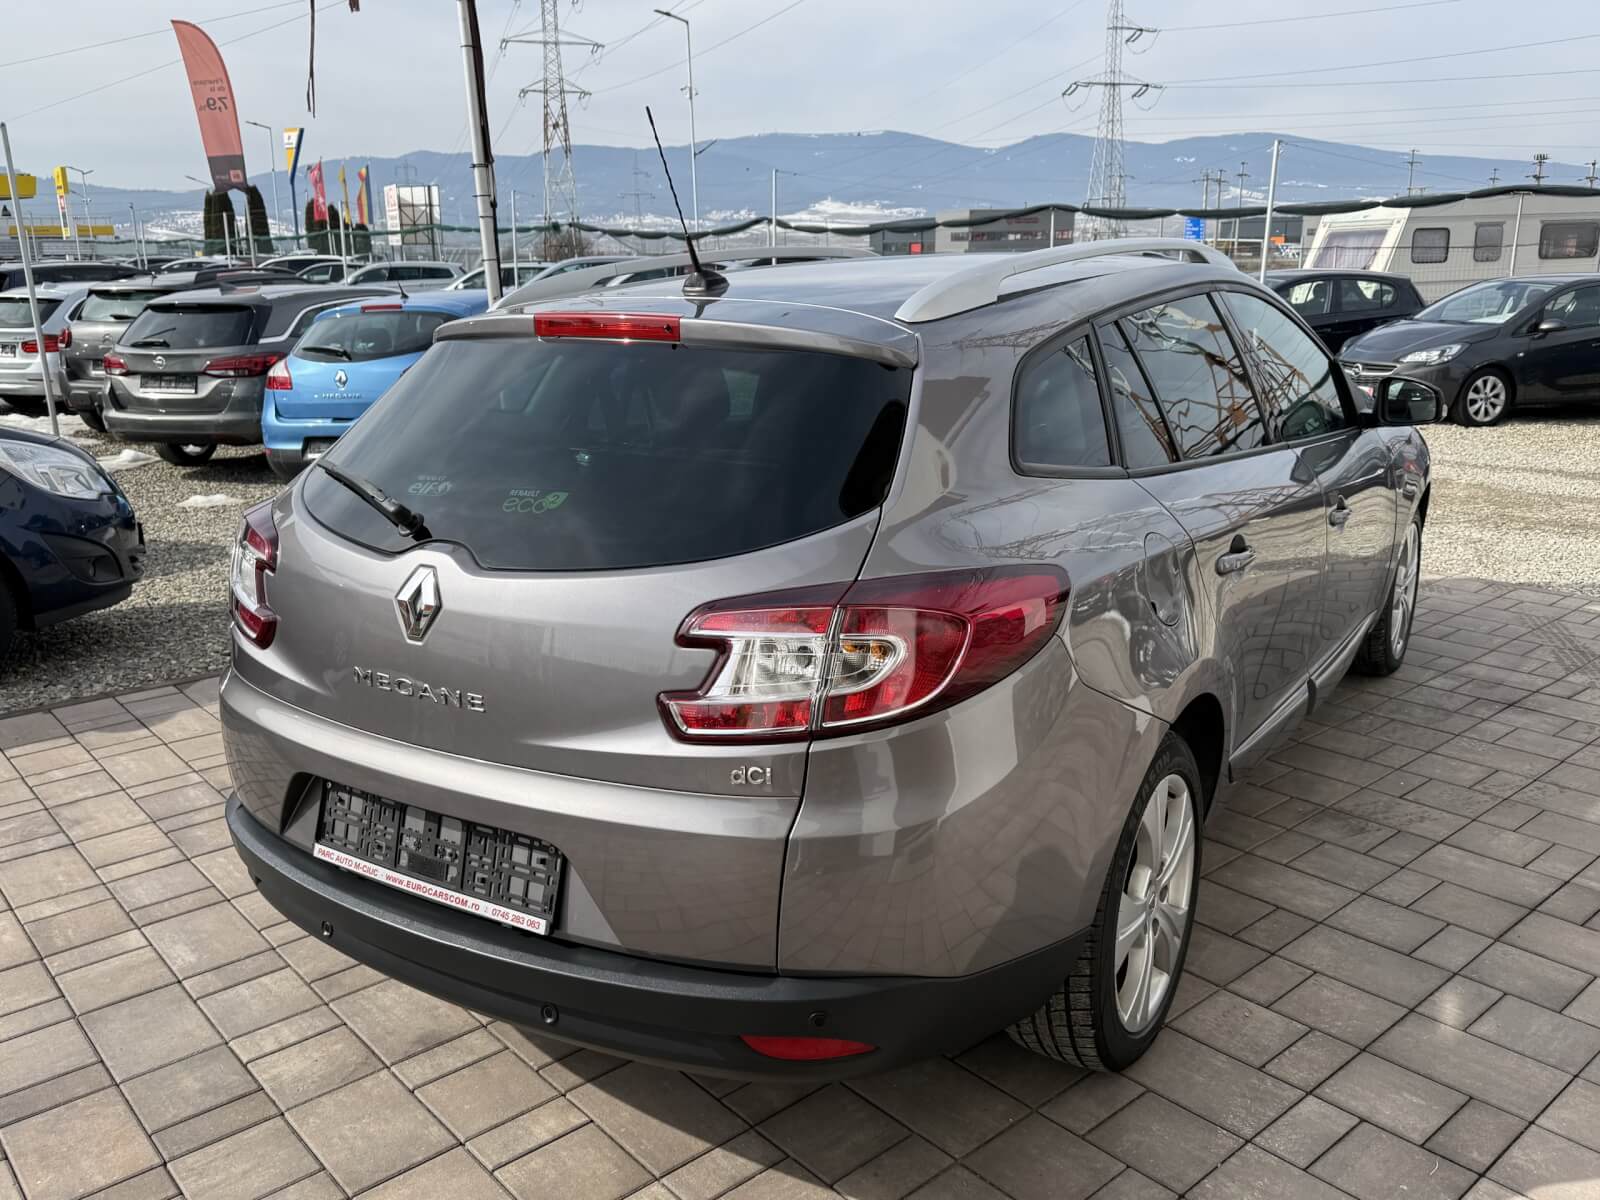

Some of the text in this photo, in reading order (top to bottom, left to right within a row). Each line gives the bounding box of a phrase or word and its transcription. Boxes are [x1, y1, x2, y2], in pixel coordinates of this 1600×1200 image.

[353, 665, 486, 713] MEGANE
[318, 847, 336, 861] PARC
[335, 855, 354, 868] AUTO
[354, 861, 379, 878] M-CIUC
[491, 907, 510, 921] 0745
